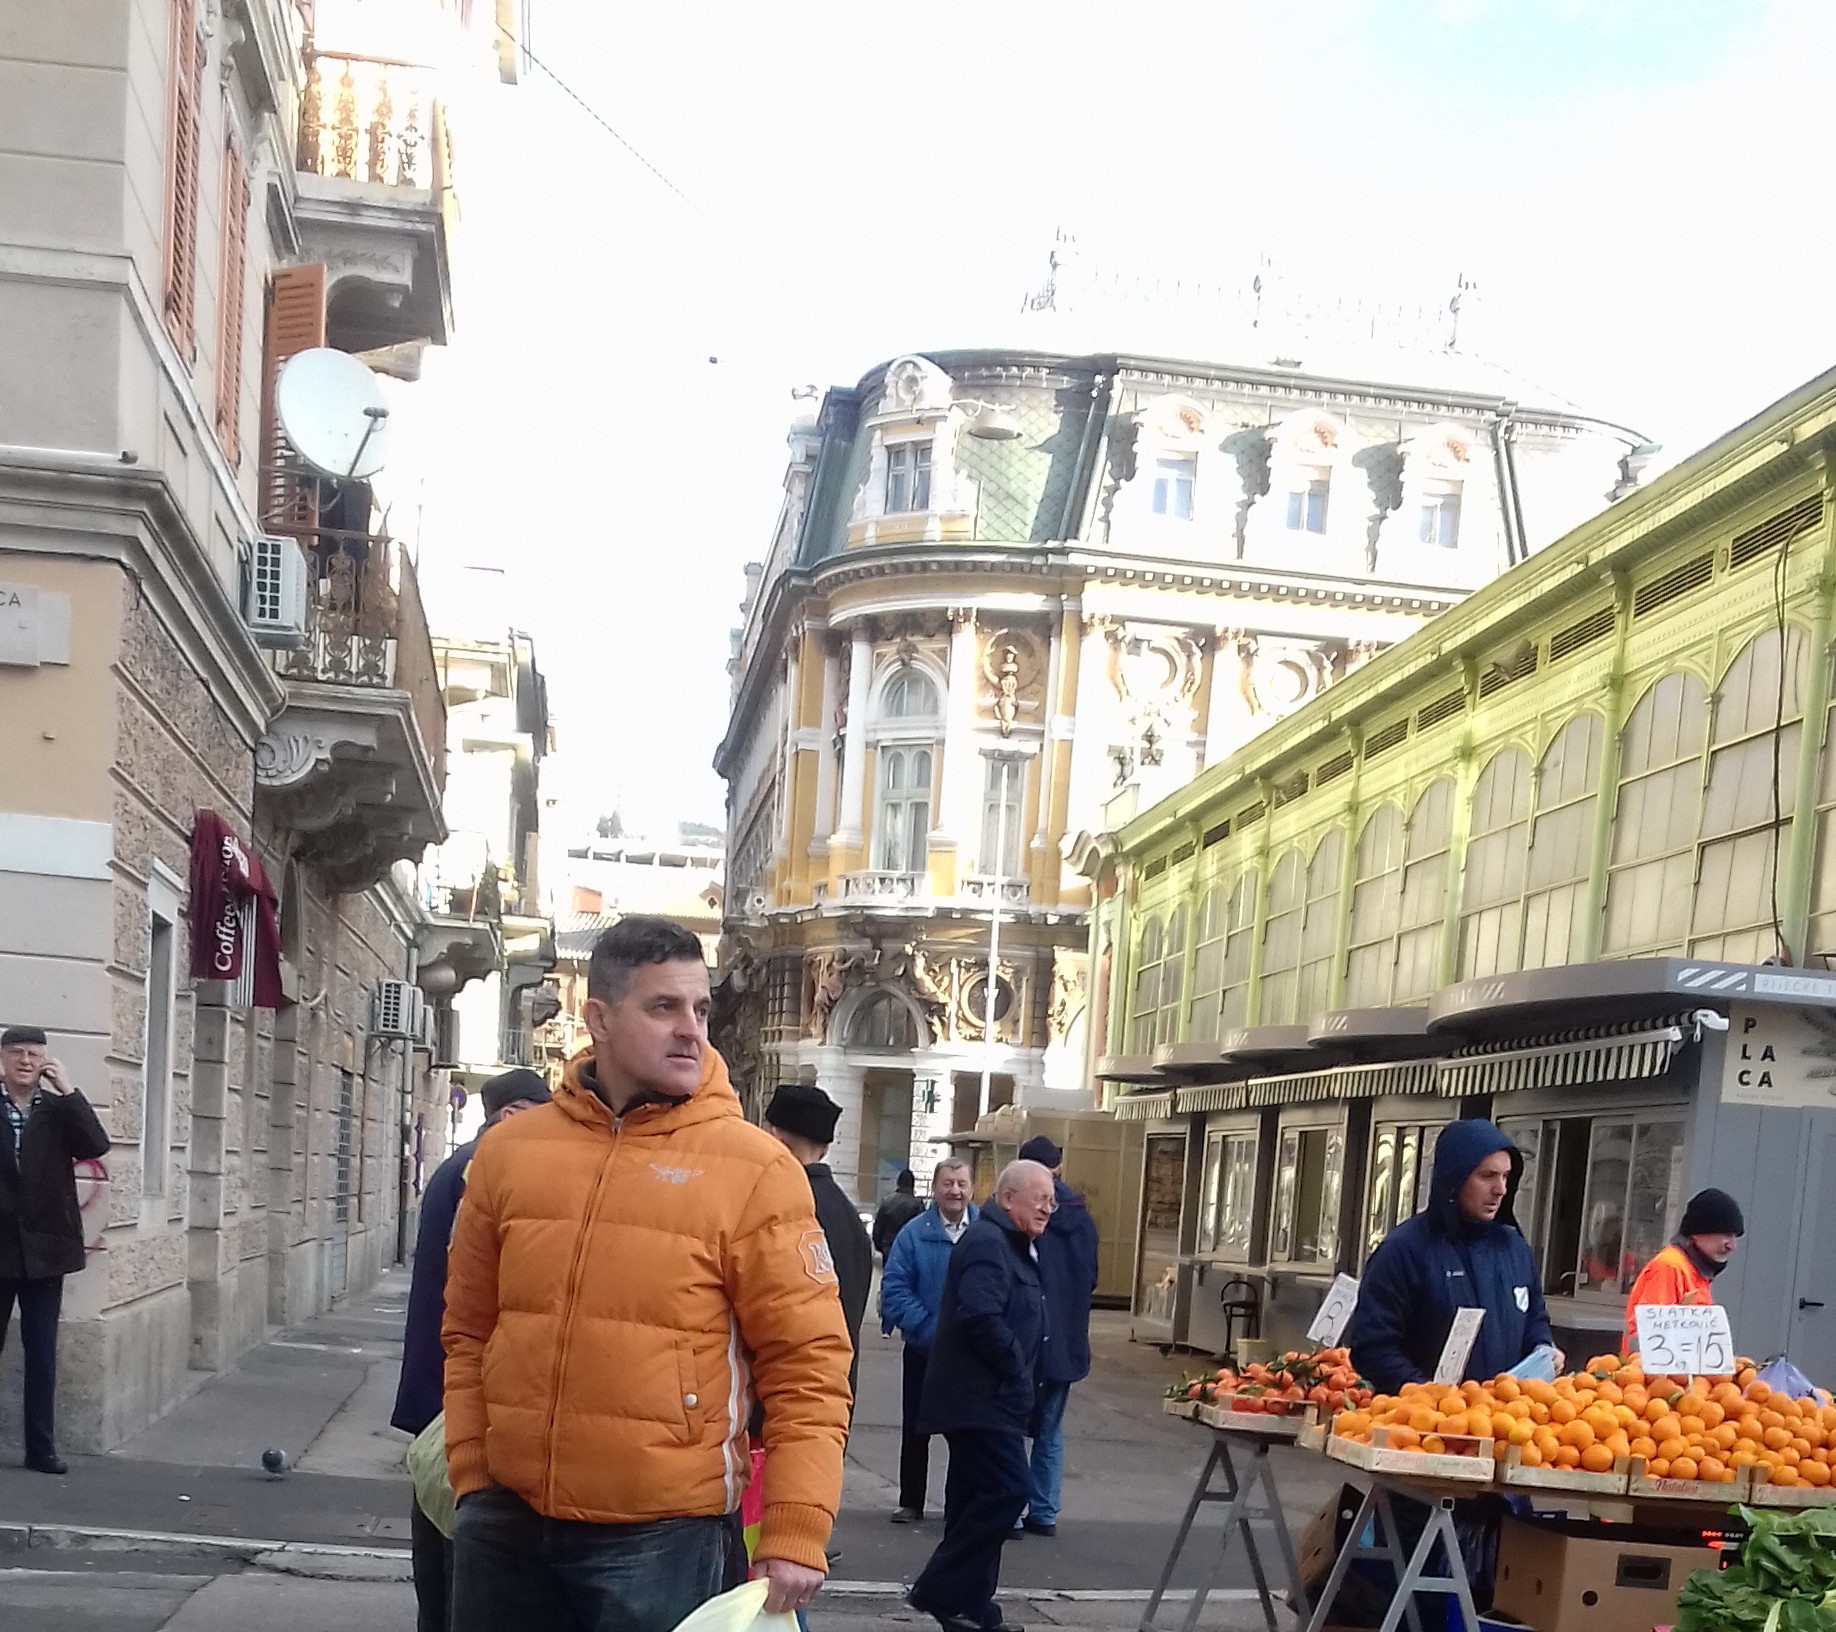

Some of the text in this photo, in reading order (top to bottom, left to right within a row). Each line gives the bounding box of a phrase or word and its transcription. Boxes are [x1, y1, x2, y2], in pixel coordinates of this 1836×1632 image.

[1743, 1017, 1757, 1034] P
[1738, 1070, 1773, 1088] CA
[1647, 1307, 1712, 1319] SLATKA
